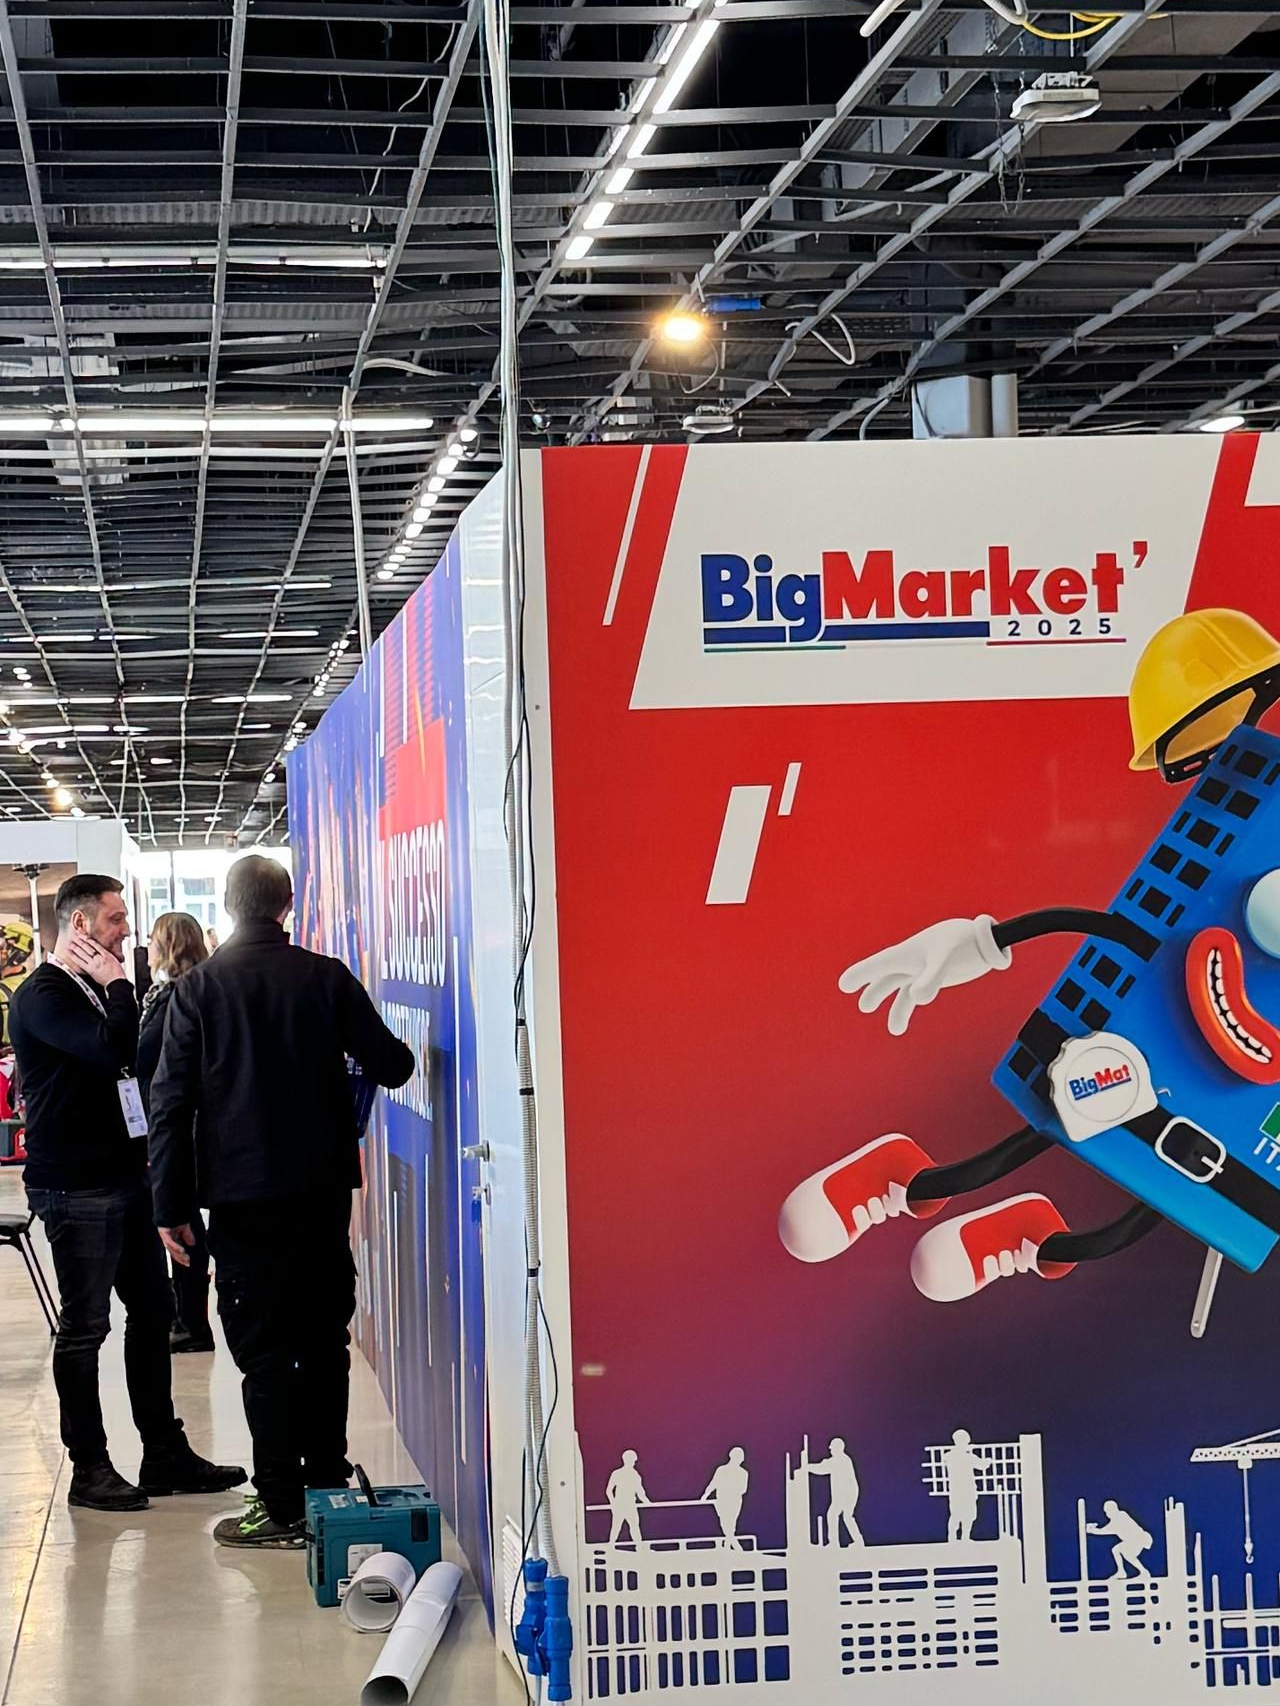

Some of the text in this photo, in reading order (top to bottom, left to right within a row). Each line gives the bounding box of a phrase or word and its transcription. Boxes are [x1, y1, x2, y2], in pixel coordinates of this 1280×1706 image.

[1008, 618, 1112, 636] 2025
[389, 819, 446, 987] SUCCESSO
[1069, 1064, 1131, 1100] BigMat
